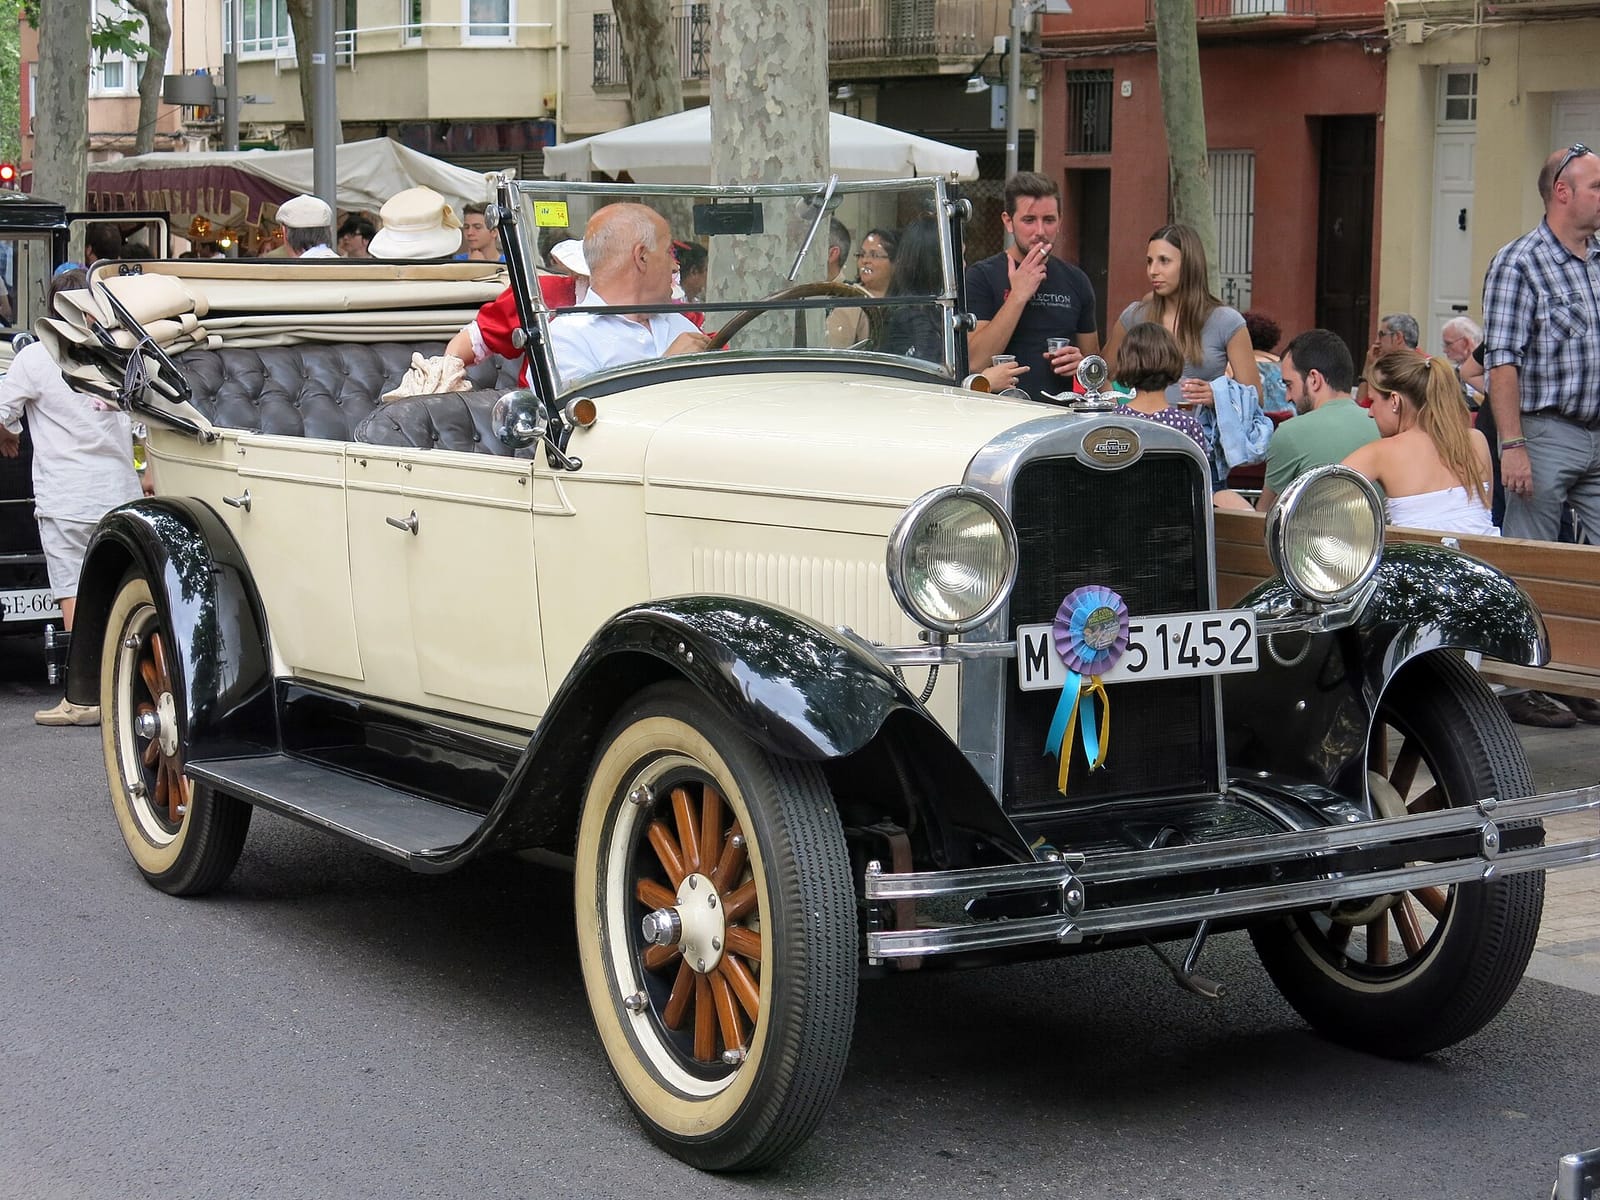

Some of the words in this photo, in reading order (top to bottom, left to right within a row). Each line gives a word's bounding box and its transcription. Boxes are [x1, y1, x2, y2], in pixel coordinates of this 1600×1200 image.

[1032, 293, 1072, 304] LECTION
[1024, 633, 1049, 682] M
[1126, 618, 1253, 673] 51452
